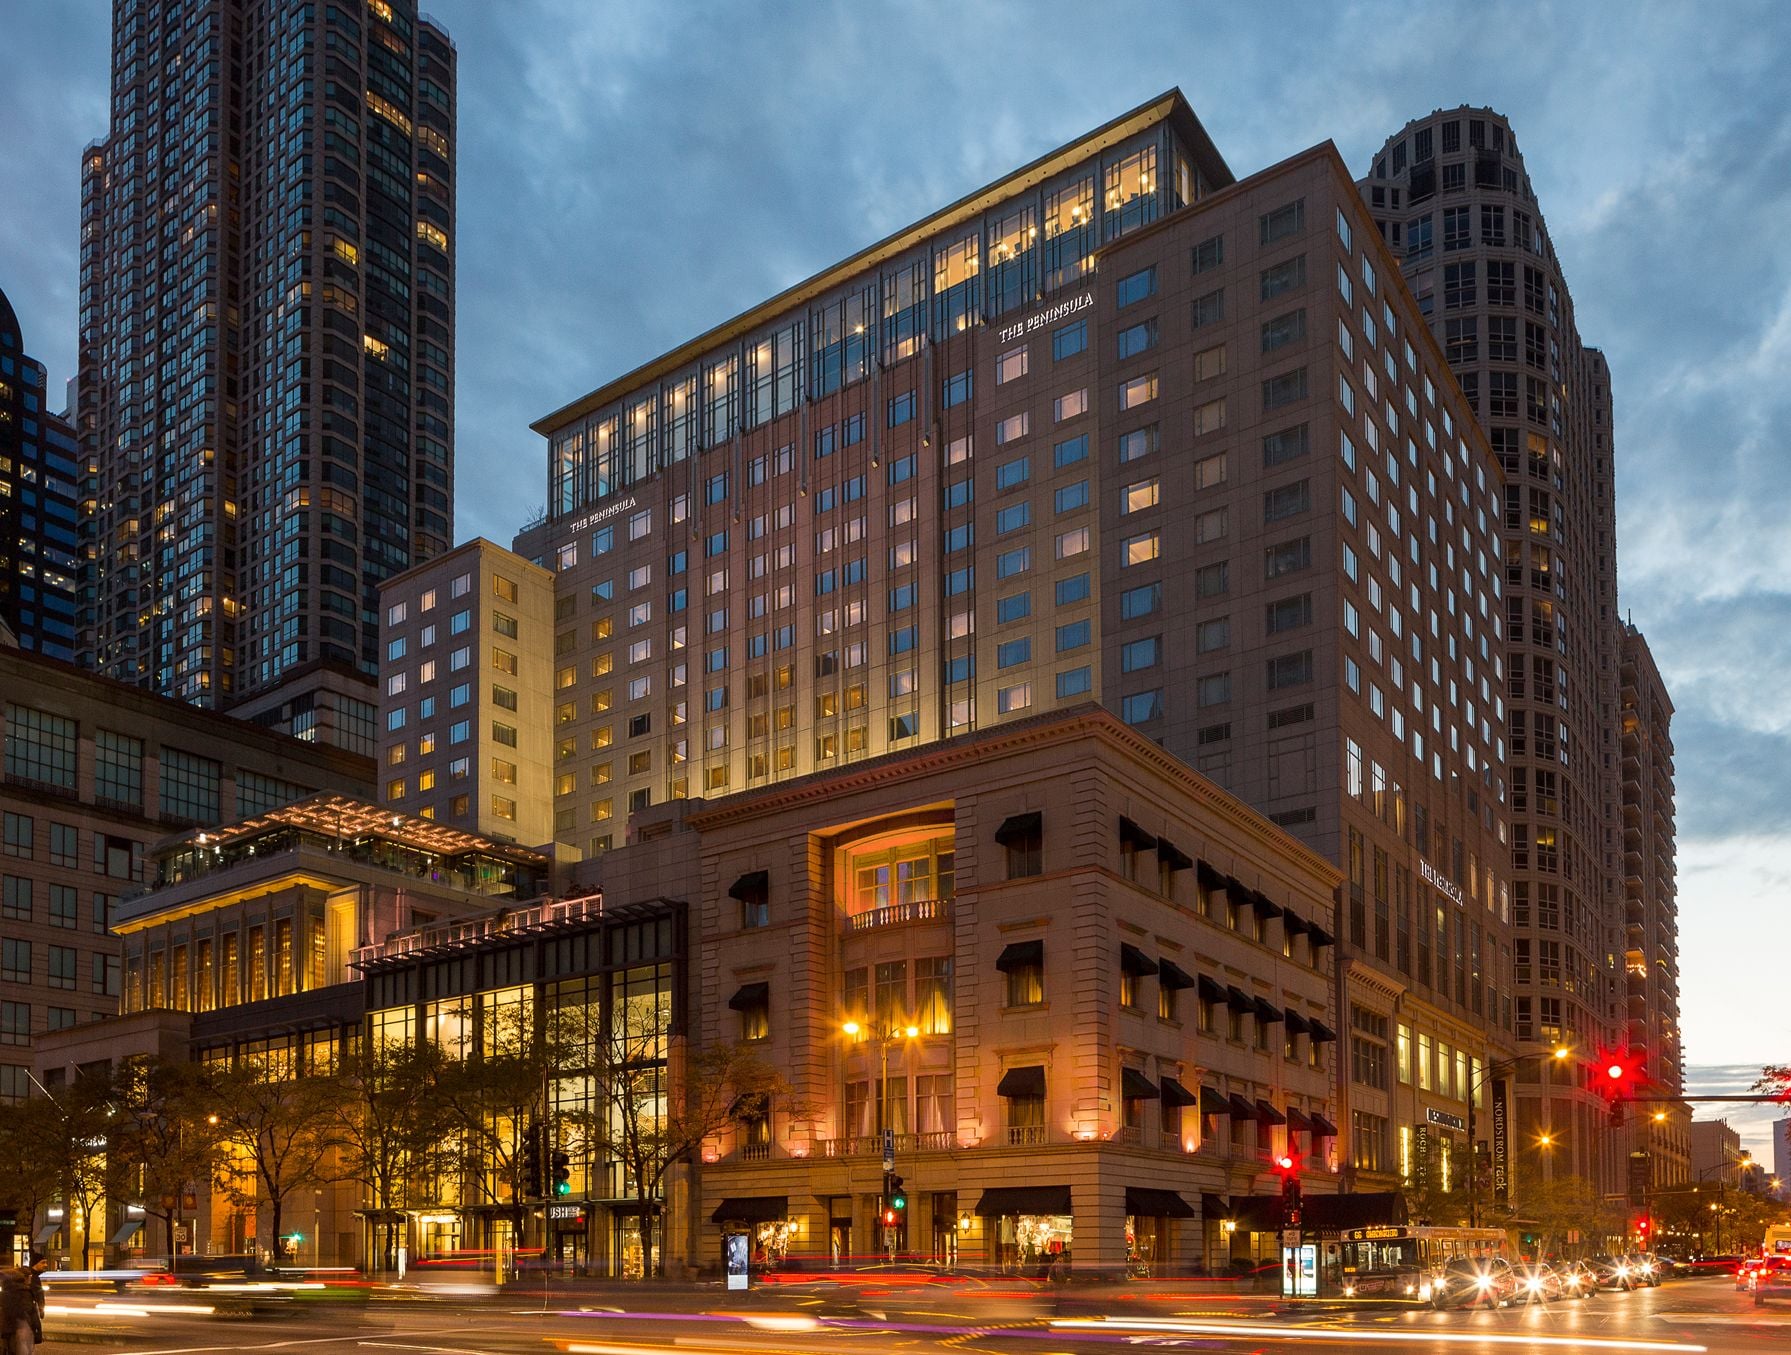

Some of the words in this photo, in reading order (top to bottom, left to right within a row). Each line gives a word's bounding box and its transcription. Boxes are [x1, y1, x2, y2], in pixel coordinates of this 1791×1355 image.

[998, 322, 1024, 344] THE
[1026, 292, 1094, 333] PENINSULA
[569, 518, 588, 534] THE
[589, 497, 636, 526] PENINSULA
[1494, 1101, 1505, 1162] NORDSTROM
[1495, 1164, 1507, 1190] rack
